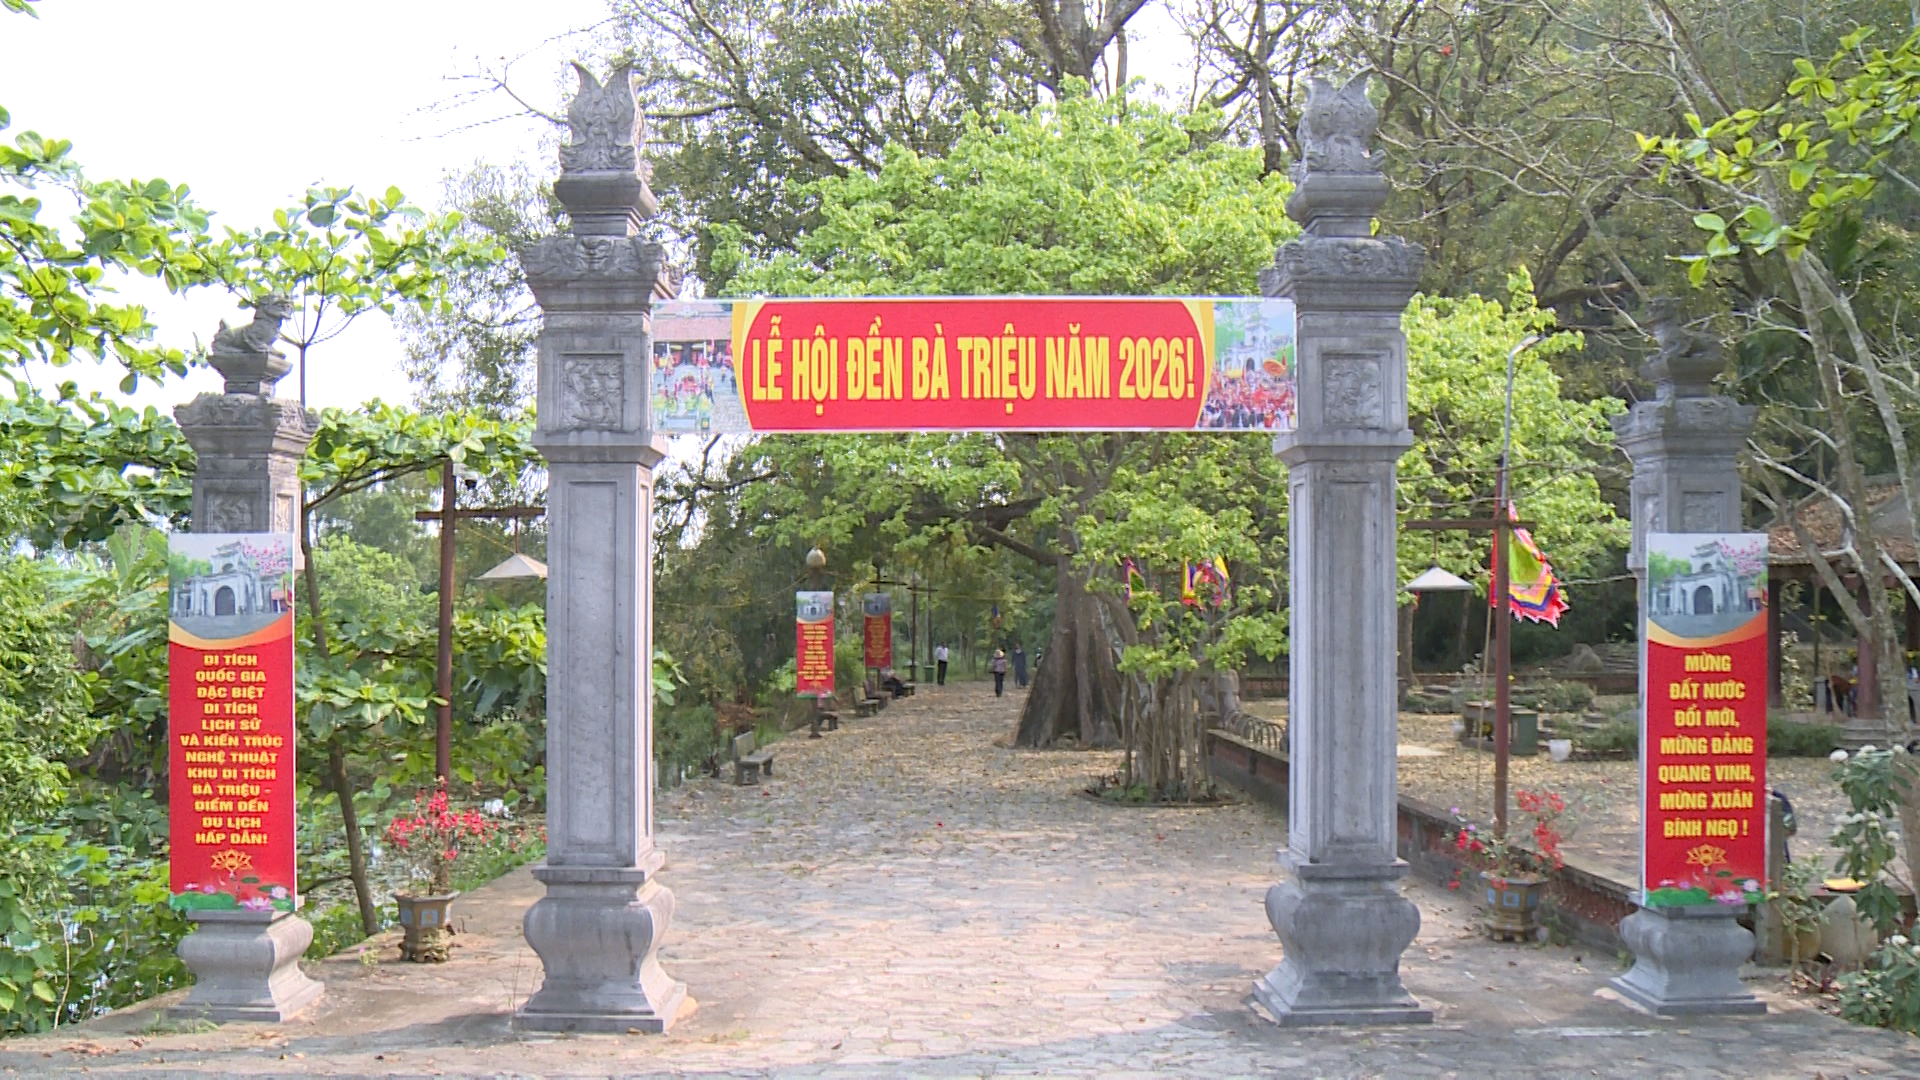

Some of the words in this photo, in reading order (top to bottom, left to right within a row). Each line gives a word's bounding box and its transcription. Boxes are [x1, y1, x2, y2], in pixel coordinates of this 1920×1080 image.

[752, 314, 783, 400] LỄ
[792, 324, 838, 415] HỘI
[846, 315, 903, 400] ĐỀN
[911, 323, 950, 400] BÀ
[957, 323, 1036, 414] TRIỆU
[1045, 323, 1111, 399] NĂM
[1118, 337, 1195, 400] 2026!
[204, 654, 219, 666] DI
[223, 653, 258, 666] TÍCH
[1685, 651, 1732, 672] MỪNG
[195, 668, 236, 682] QUỐC
[240, 671, 267, 682] GIA
[196, 685, 228, 700] ĐẶC
[231, 685, 265, 700] BIỆT
[1669, 677, 1700, 699] ĐẤT
[1703, 678, 1746, 700] NƯỚC
[204, 703, 220, 714] DI
[223, 701, 258, 714] TÍCH
[1674, 703, 1701, 726] ĐỔI
[1705, 706, 1740, 728] MỚI,
[201, 718, 236, 731] LỊCH
[239, 717, 262, 731] SỬ
[180, 733, 200, 746] VÀ
[203, 733, 239, 746] KIẾN
[1660, 734, 1708, 754] MỪNG
[1711, 731, 1754, 754] ĐẢNG
[185, 750, 226, 765] NGHỆ
[229, 751, 278, 766] THUẬT
[187, 768, 218, 779] KHU
[222, 768, 238, 779] DI
[241, 767, 276, 780] TÍCH
[1658, 765, 1711, 784] QUANG
[1714, 763, 1755, 783] VINH,
[192, 782, 213, 795] BÀ
[217, 783, 260, 798] TRIỆU
[1659, 789, 1707, 809] MỪNG
[1711, 788, 1754, 809] XUÂN
[202, 817, 223, 828] DU
[227, 816, 261, 829] LỊCH
[1664, 817, 1702, 837] BÍNH
[1706, 819, 1738, 839] NGỌ
[195, 830, 226, 844] HẤP
[230, 830, 268, 844] DẪN!
